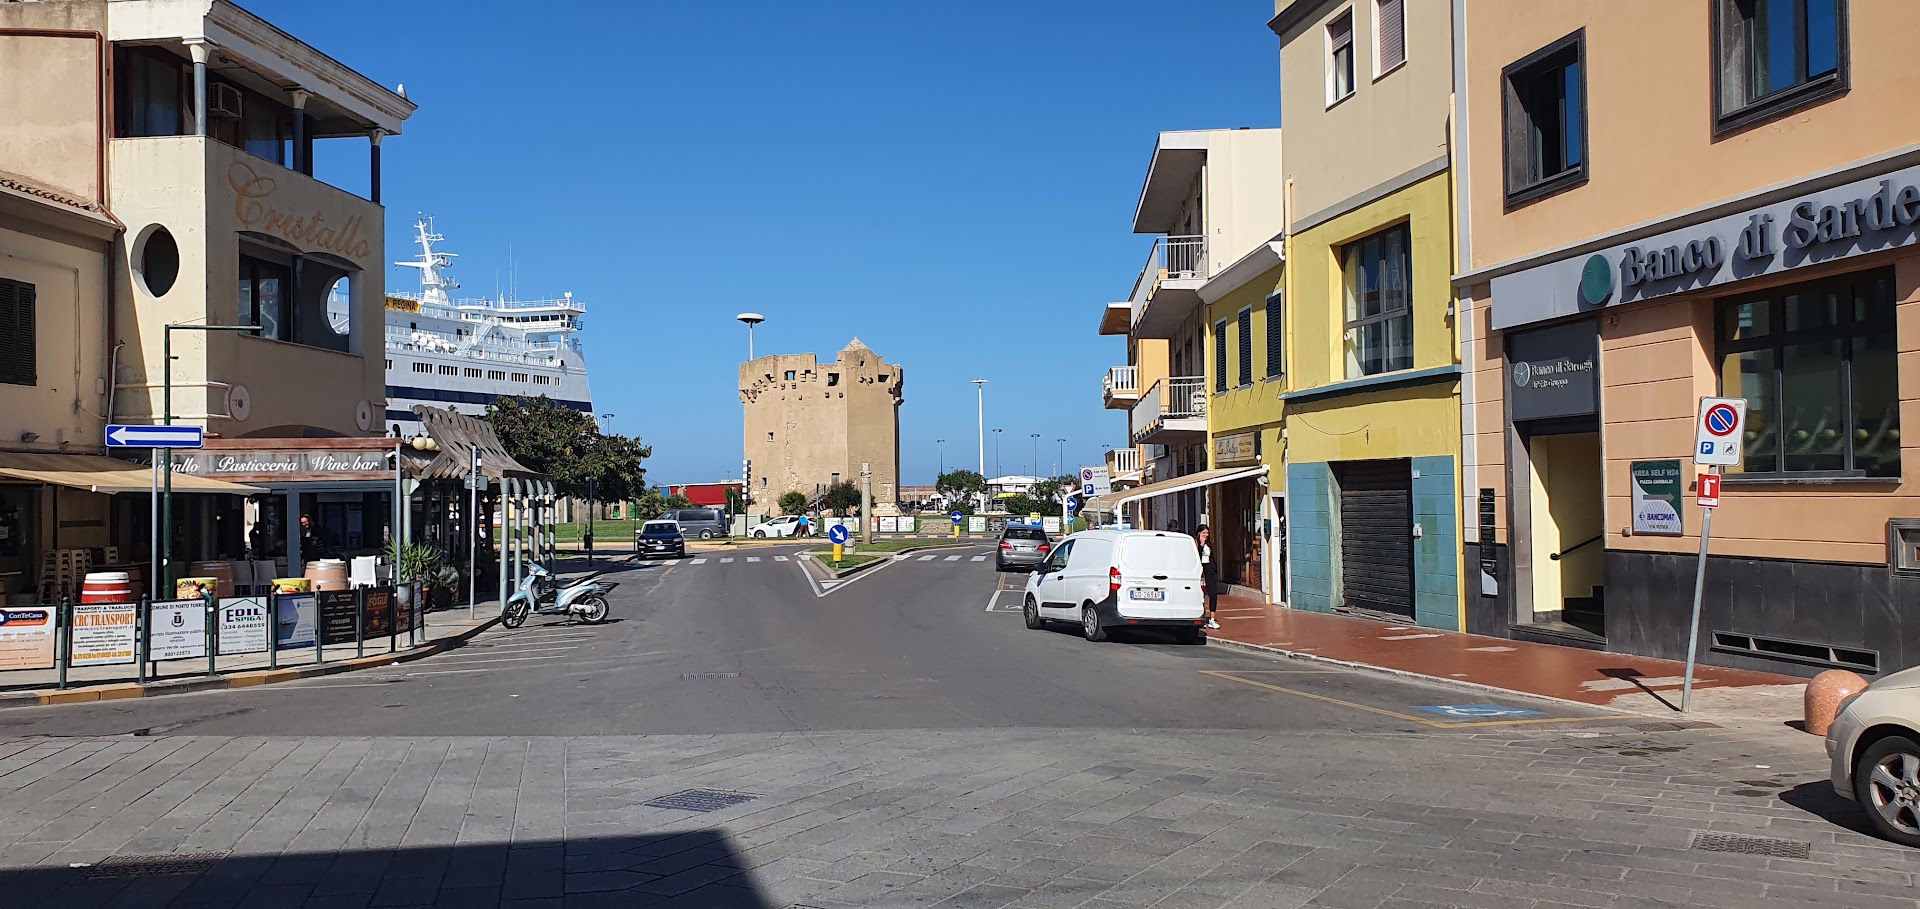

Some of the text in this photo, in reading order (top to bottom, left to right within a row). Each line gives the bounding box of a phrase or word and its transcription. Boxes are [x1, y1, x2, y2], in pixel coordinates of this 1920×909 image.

[228, 161, 372, 259] Cristallo
[1624, 234, 1723, 287] Banco
[1739, 213, 1776, 261] di
[1703, 443, 1712, 453] P
[216, 456, 300, 472] Pasticceria
[311, 455, 351, 471] Wine
[352, 455, 380, 471] bar
[1650, 469, 1666, 477] SELF
[1646, 513, 1675, 521] BANCOMAT
[74, 612, 134, 627] CRC TRANSPORT
[226, 608, 263, 623] EDIL
